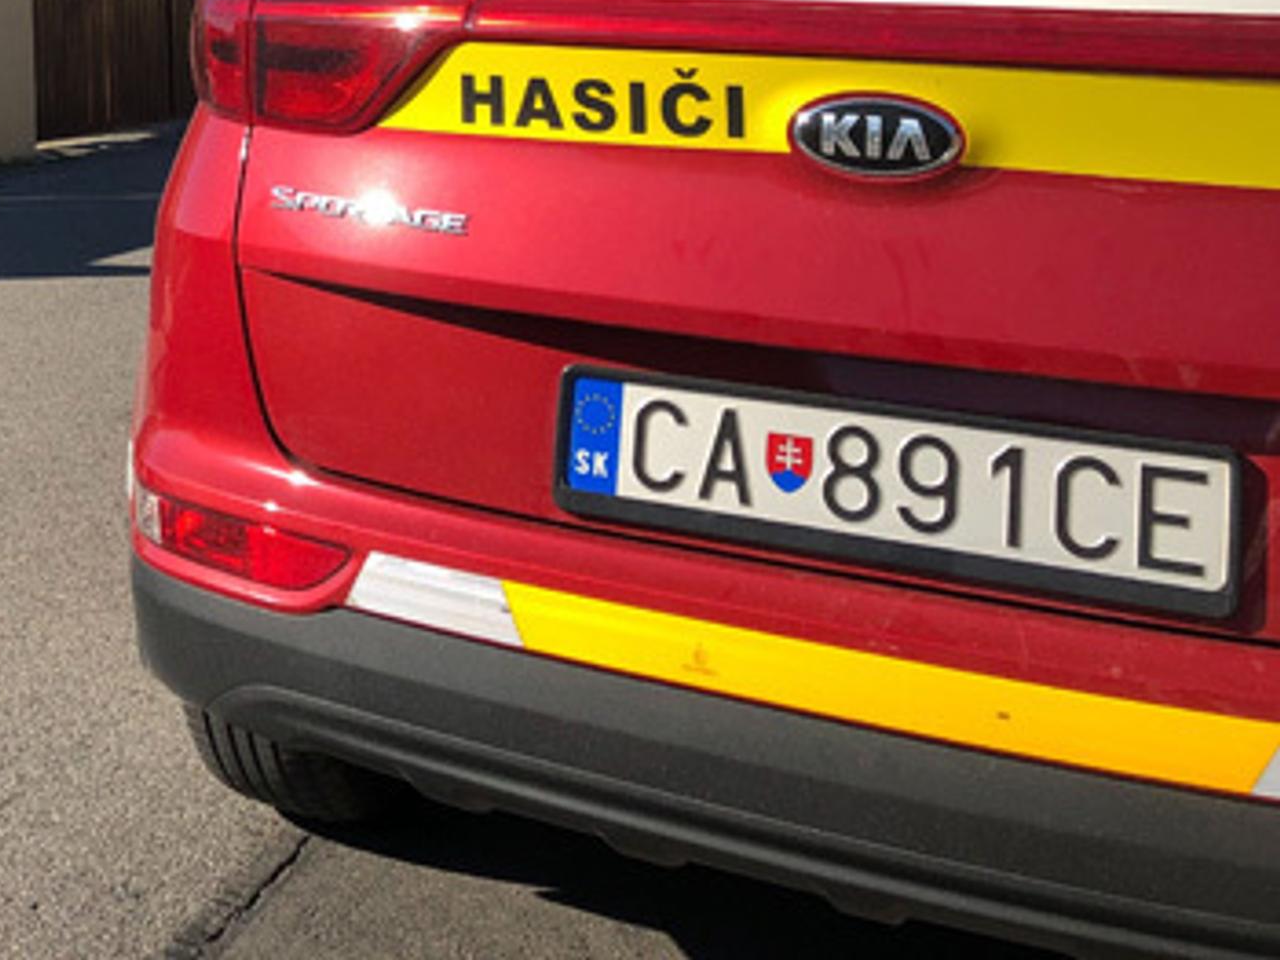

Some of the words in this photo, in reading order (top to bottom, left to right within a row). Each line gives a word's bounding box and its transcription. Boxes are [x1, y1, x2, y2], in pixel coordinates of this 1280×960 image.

[460, 67, 744, 138] HASIČI
[821, 112, 932, 161] KIA
[271, 185, 470, 236] SPORAGE
[574, 448, 608, 478] SK
